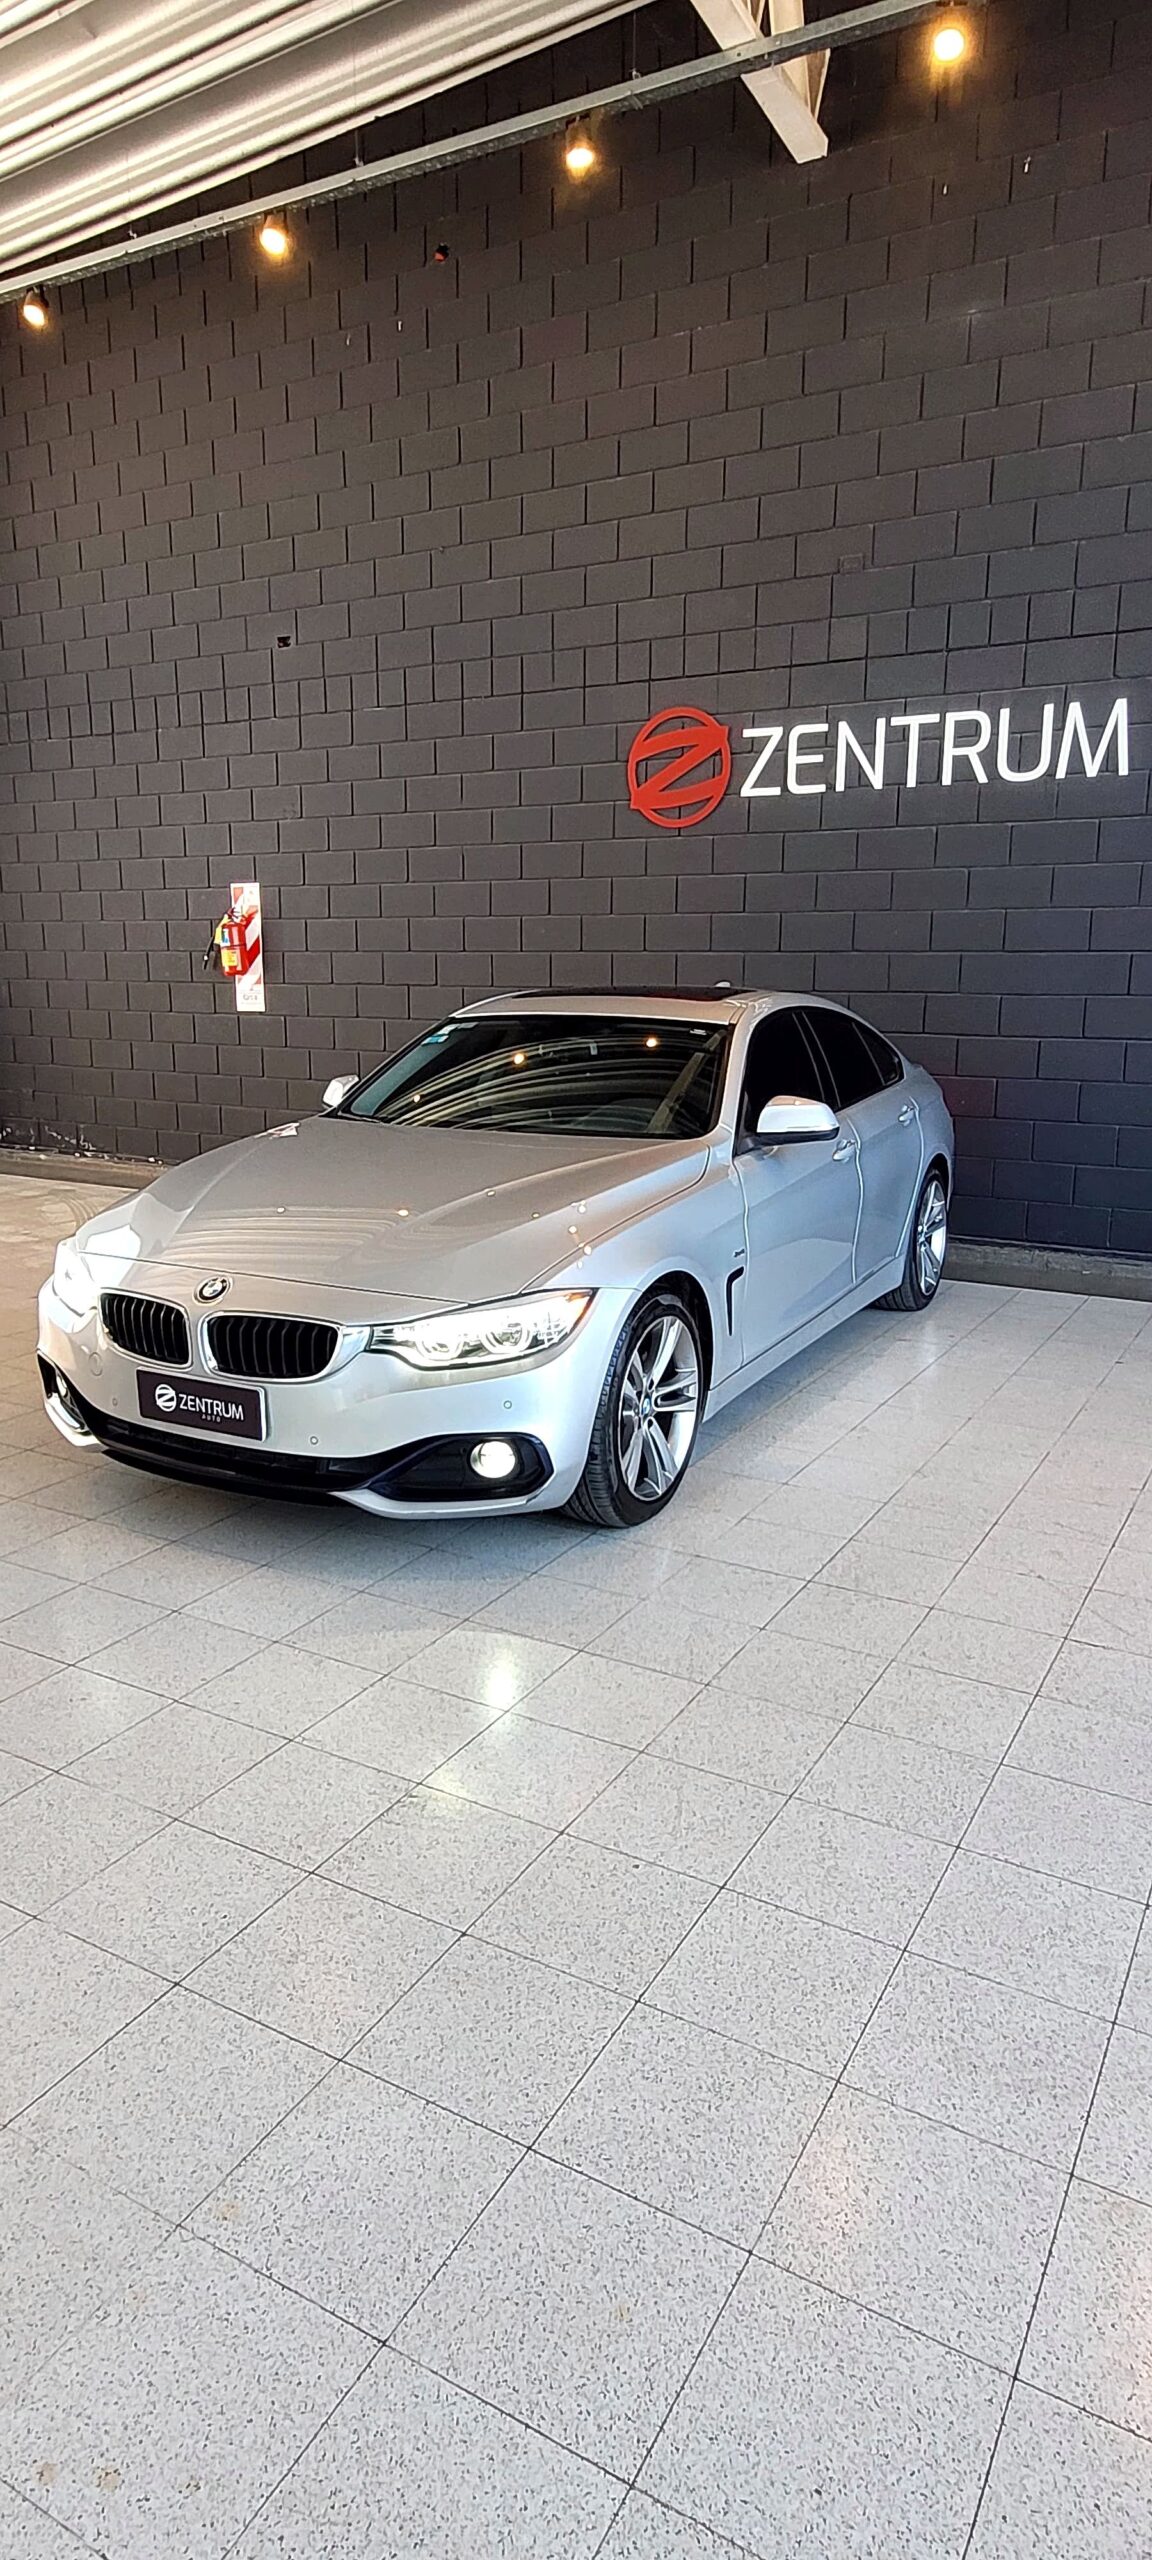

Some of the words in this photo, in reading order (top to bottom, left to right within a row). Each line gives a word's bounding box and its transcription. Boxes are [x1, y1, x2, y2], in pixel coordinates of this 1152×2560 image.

[740, 697, 1130, 798] ZENTRUM
[178, 1393, 244, 1421] ZENTRUM
[201, 1413, 221, 1423] AUTO
